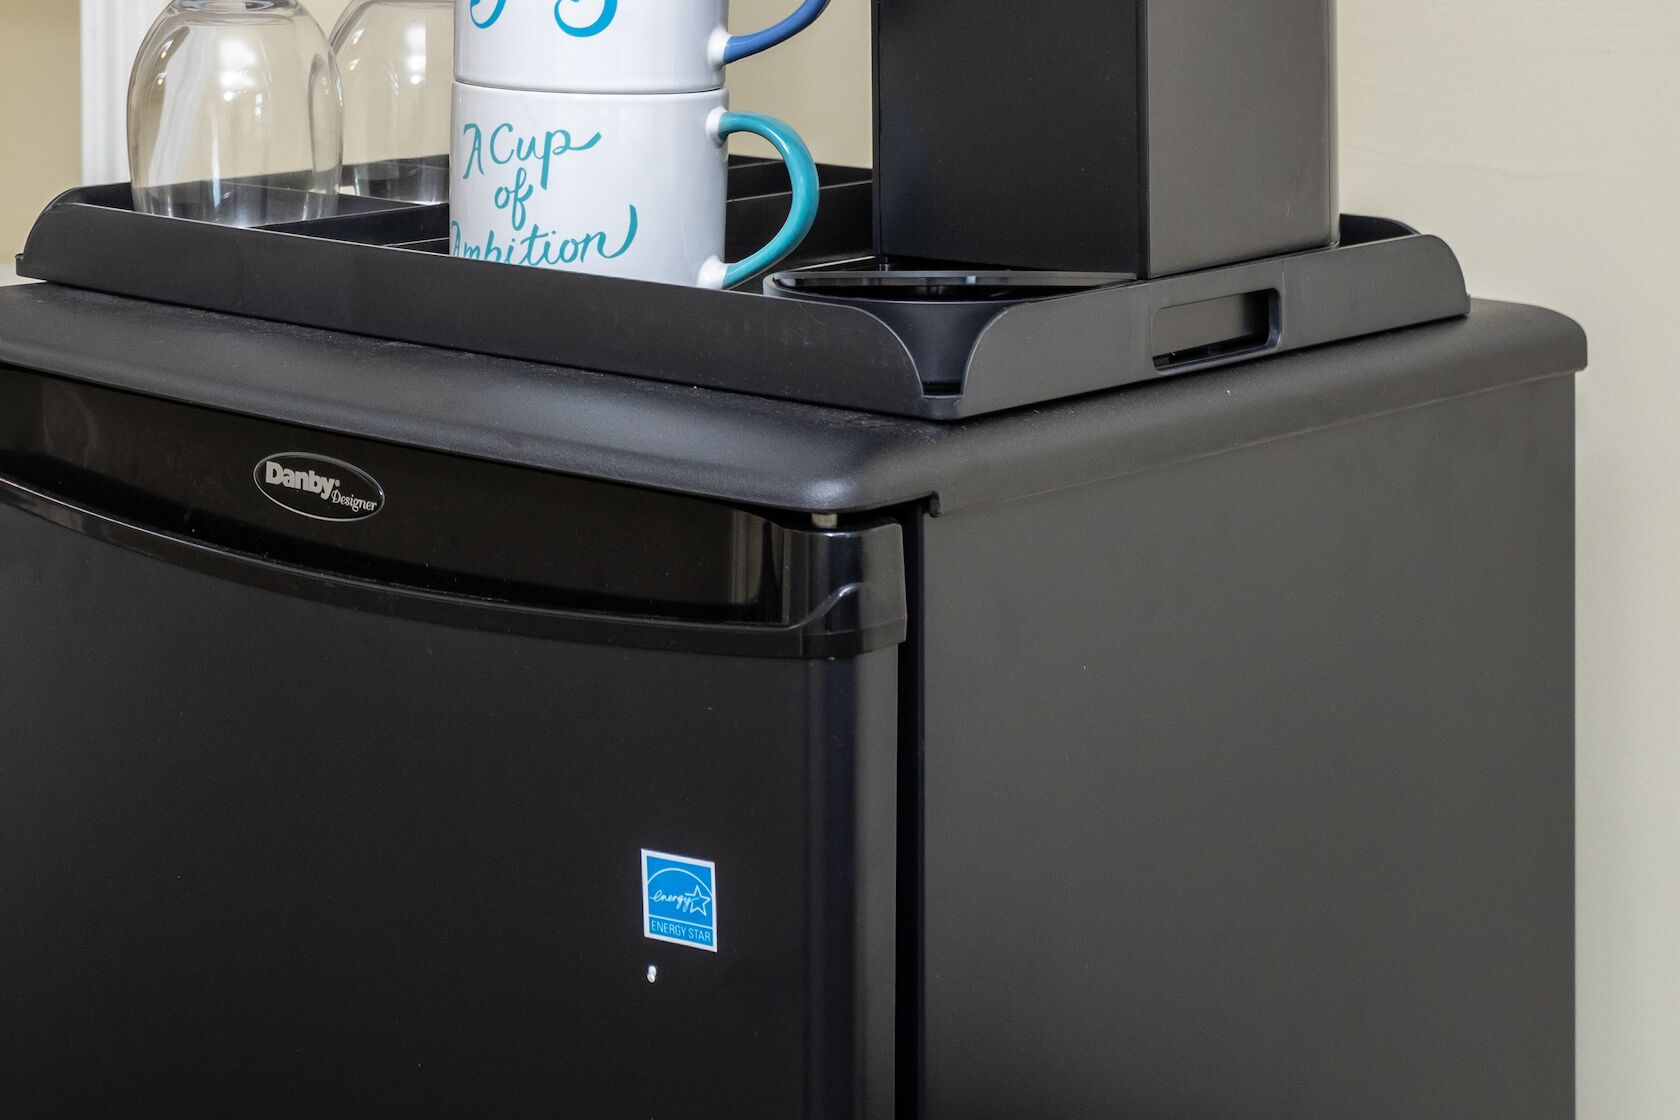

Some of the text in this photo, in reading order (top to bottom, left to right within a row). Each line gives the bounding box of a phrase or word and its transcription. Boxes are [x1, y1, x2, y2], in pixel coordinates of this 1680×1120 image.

[463, 123, 602, 190] A Cup
[494, 167, 534, 231] of
[331, 489, 378, 513] Designer
[650, 889, 693, 913] energy
[651, 919, 711, 942] ENERGY STAR
